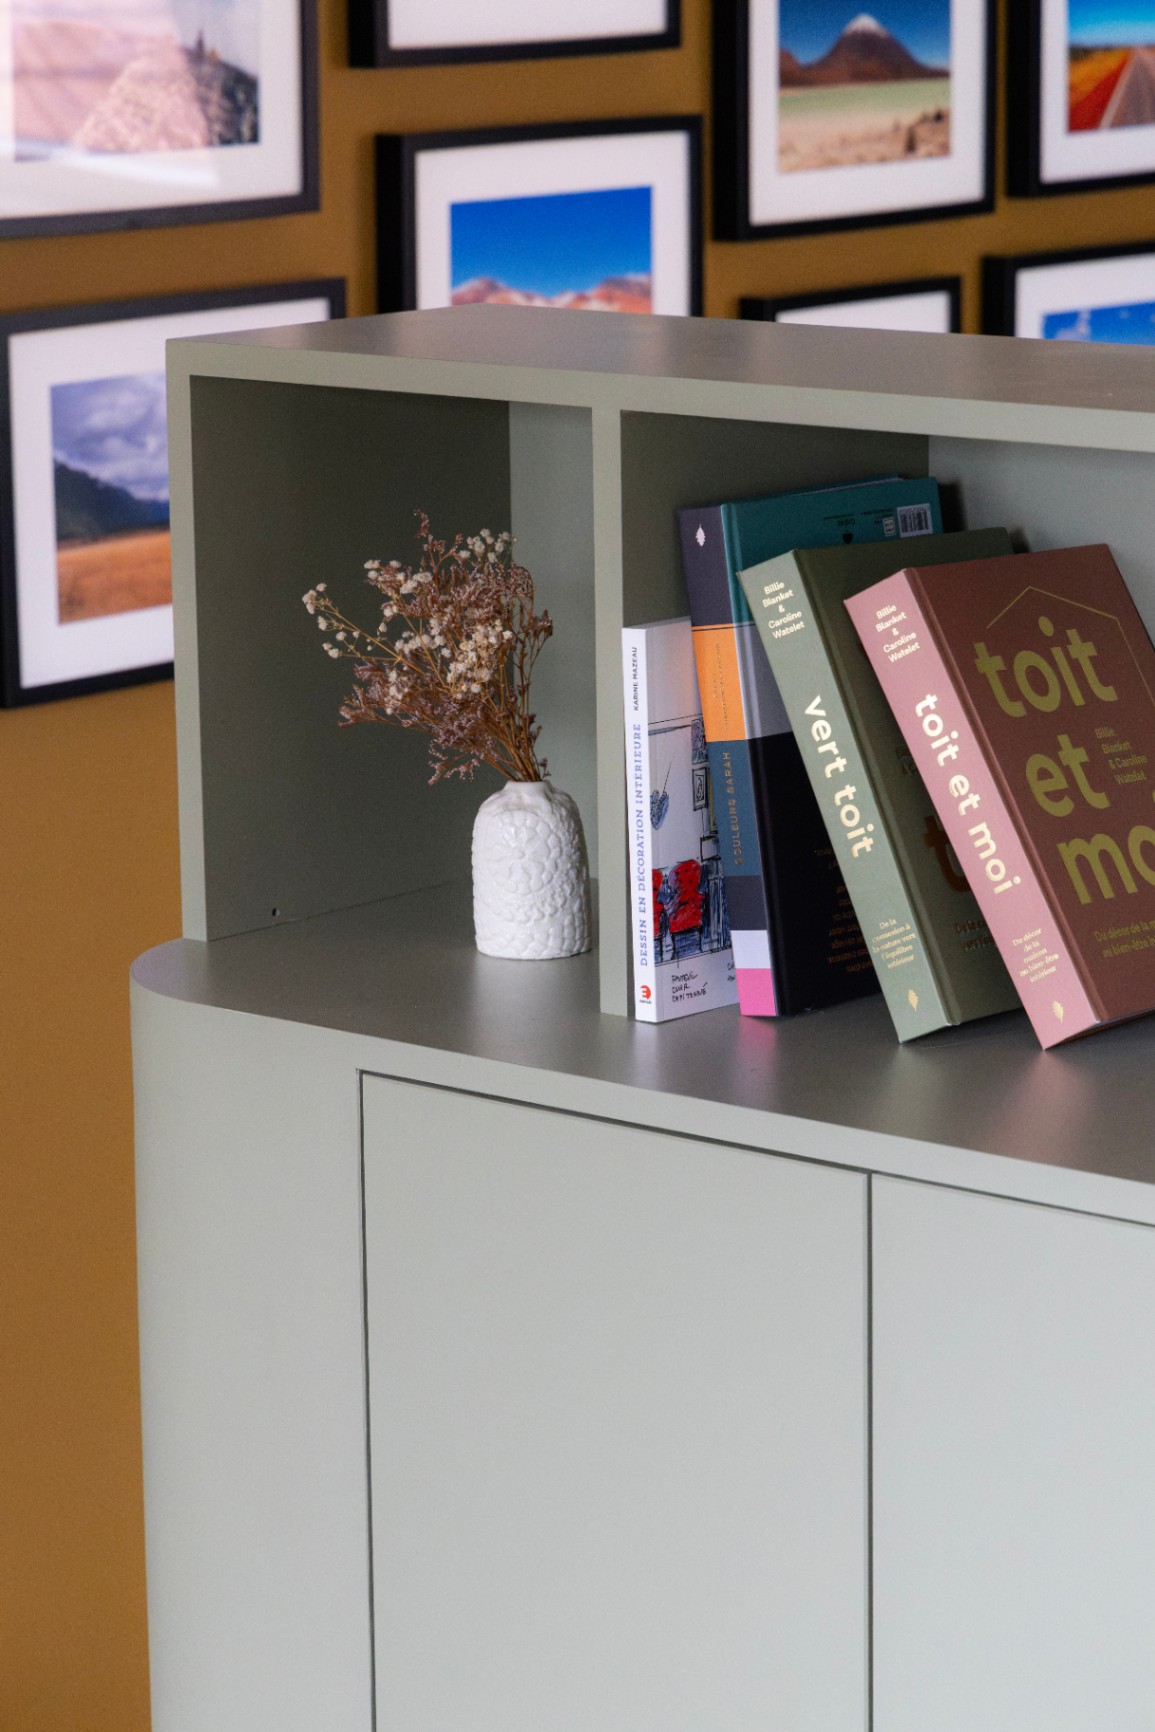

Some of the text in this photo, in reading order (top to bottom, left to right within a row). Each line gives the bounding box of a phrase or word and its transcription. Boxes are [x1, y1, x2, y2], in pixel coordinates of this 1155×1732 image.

[762, 589, 794, 608] Blanket
[763, 581, 785, 595] Billie
[778, 604, 786, 613] &
[875, 604, 897, 620] Billie
[768, 610, 803, 629] Caroline
[772, 621, 805, 639] Watelet
[875, 611, 907, 633] Blanket
[883, 631, 917, 653] Caroline
[891, 627, 899, 637] &
[888, 642, 921, 663] Watelet
[973, 615, 1119, 718] toit
[632, 681, 640, 711] KARINE
[1116, 754, 1148, 769] Caroline
[804, 695, 875, 858] vert toit
[1025, 733, 1111, 818] et
[1113, 770, 1147, 785] Watelet
[915, 693, 960, 767] toit
[949, 774, 981, 816] et
[968, 822, 1022, 895] moi
[722, 751, 743, 865] COULEURS SARAH
[1056, 824, 1155, 906] mo
[639, 896, 646, 914] EN
[640, 919, 648, 967] DESSIN
